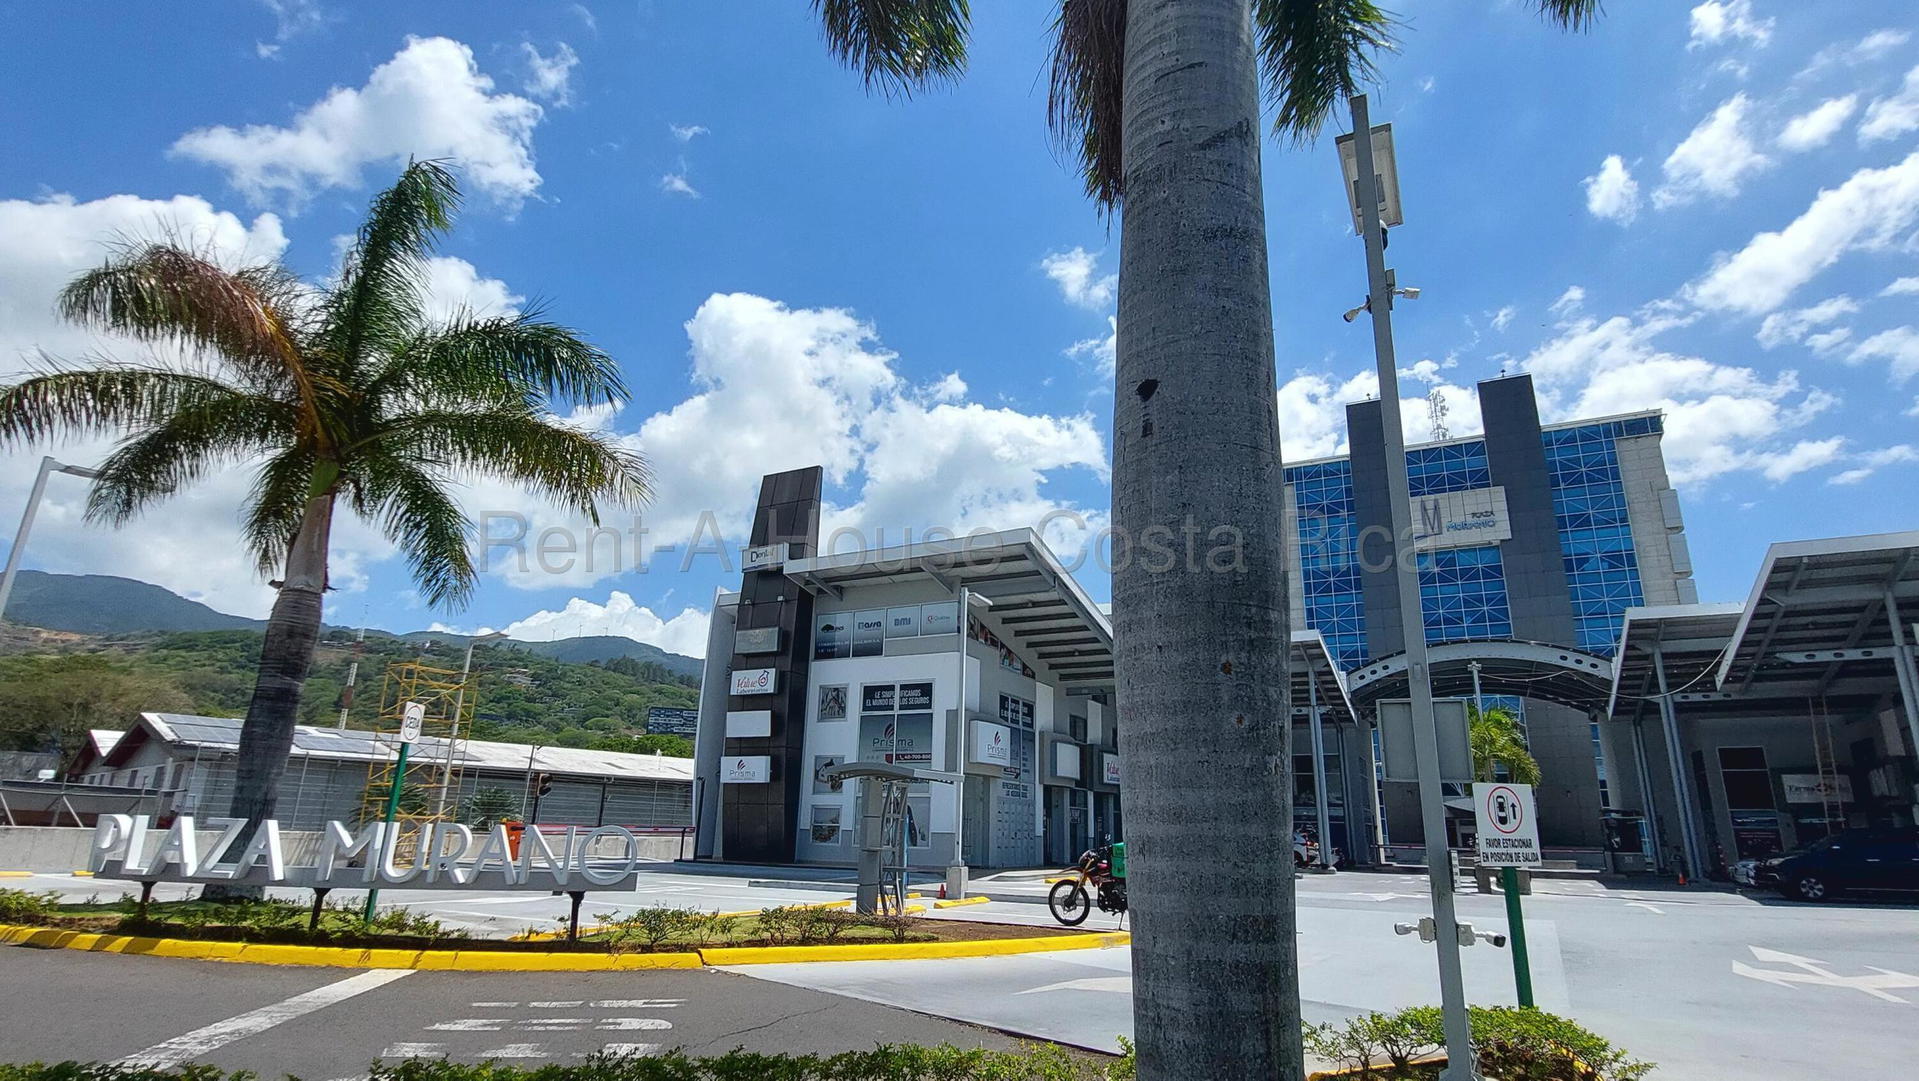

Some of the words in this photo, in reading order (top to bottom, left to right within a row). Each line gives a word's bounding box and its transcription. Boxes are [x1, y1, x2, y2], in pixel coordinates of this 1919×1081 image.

[872, 737, 914, 747] Prisma
[729, 769, 756, 777] Prisma
[1485, 838, 1501, 848] FAVOR
[1501, 838, 1533, 849] ESTACIONAR
[87, 813, 285, 881] PLAZA
[314, 820, 638, 886] MURANO
[1482, 852, 1490, 862] EN
[1514, 852, 1522, 862] DE
[1522, 852, 1540, 863] SALIDA
